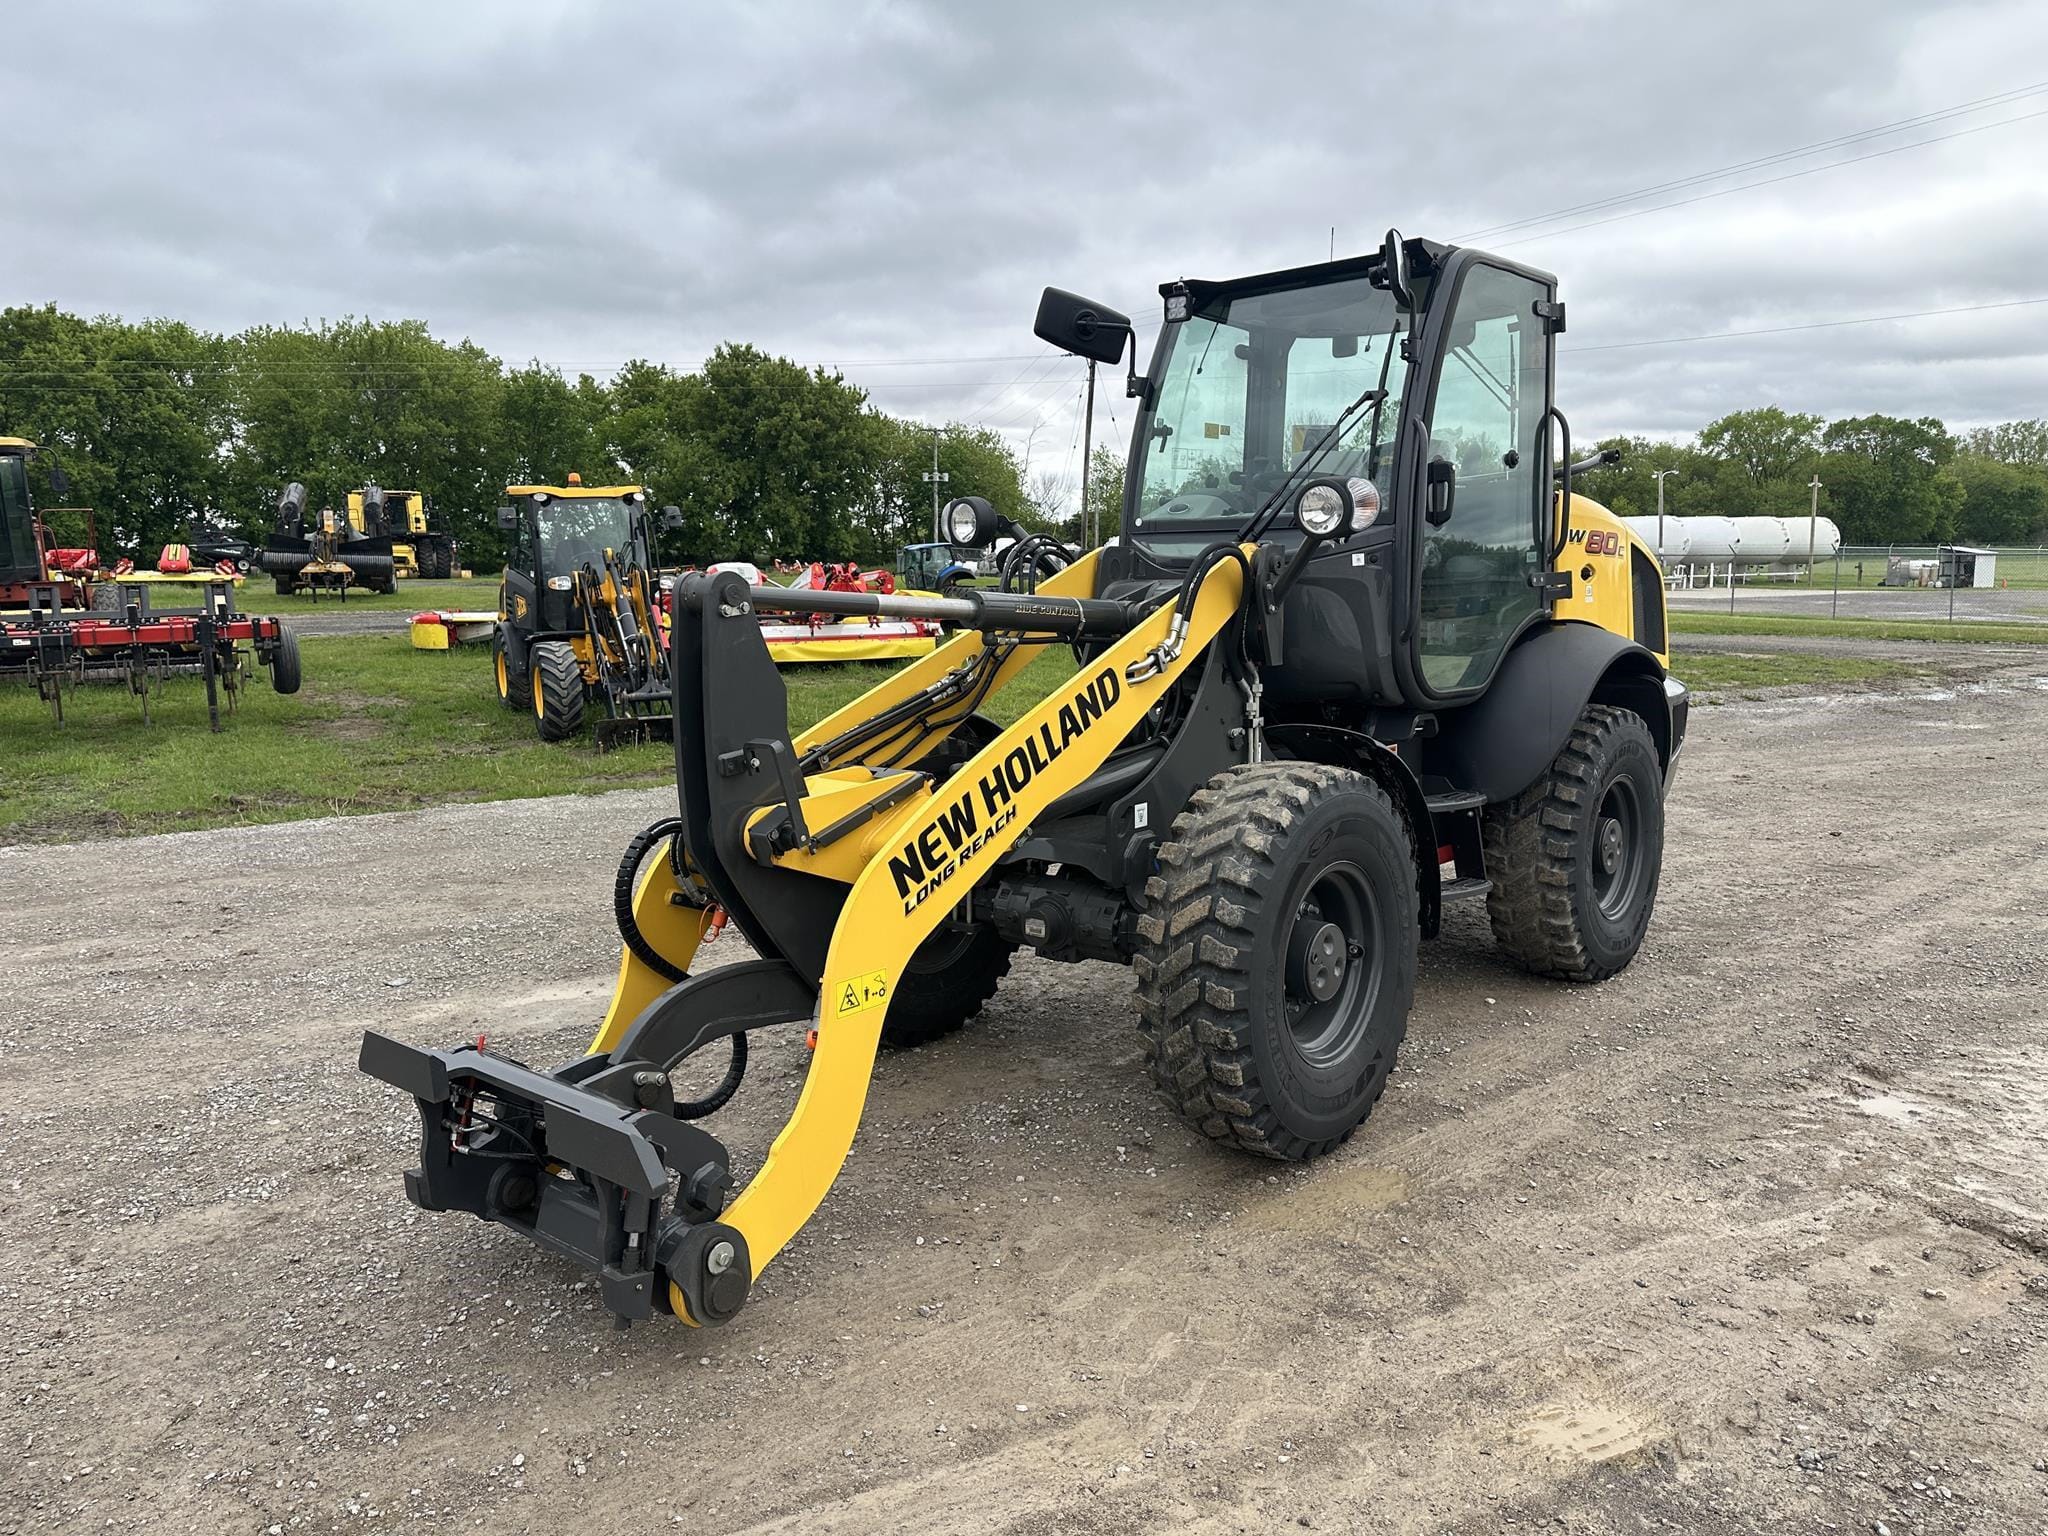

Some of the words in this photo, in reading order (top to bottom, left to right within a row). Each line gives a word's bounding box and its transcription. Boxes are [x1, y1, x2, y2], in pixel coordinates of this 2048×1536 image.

[888, 792, 977, 899] NEW
[978, 667, 1120, 818] HOLLAND
[904, 861, 955, 917] LONG
[959, 803, 1018, 868] REACH
